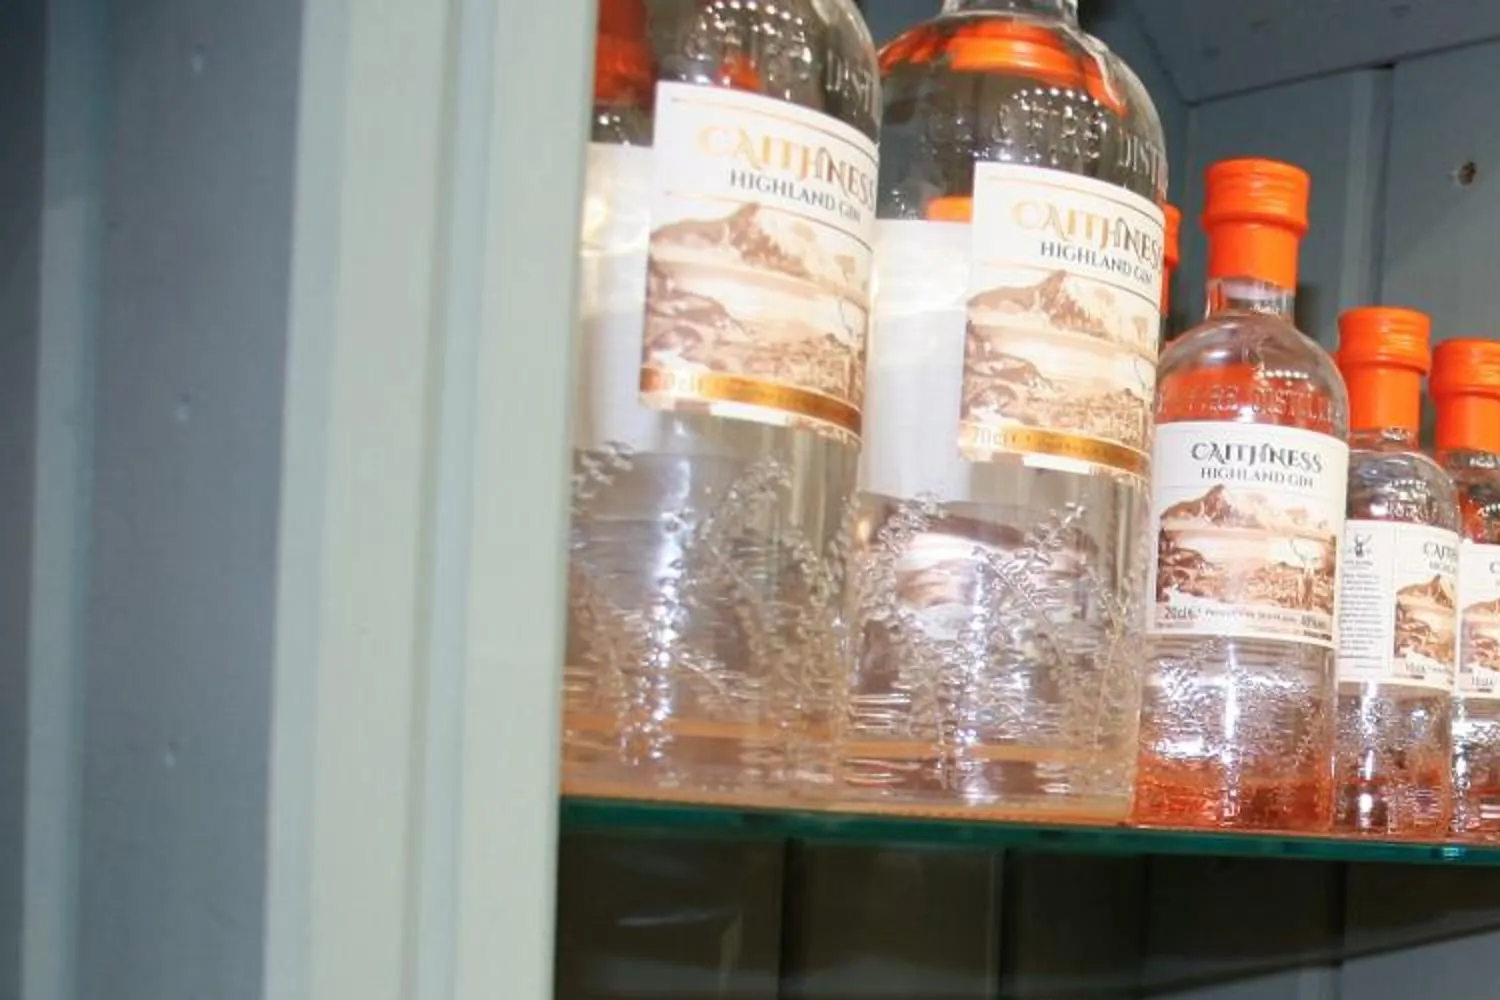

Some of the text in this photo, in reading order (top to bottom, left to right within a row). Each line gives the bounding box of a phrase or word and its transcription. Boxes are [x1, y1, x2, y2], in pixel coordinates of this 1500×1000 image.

[730, 166, 861, 224] HIGHLAND GIN
[1040, 240, 1152, 285] HIGHLAND GIN
[1190, 442, 1323, 474] CAITHNESS
[1201, 467, 1314, 488] HIGHLAND GIN
